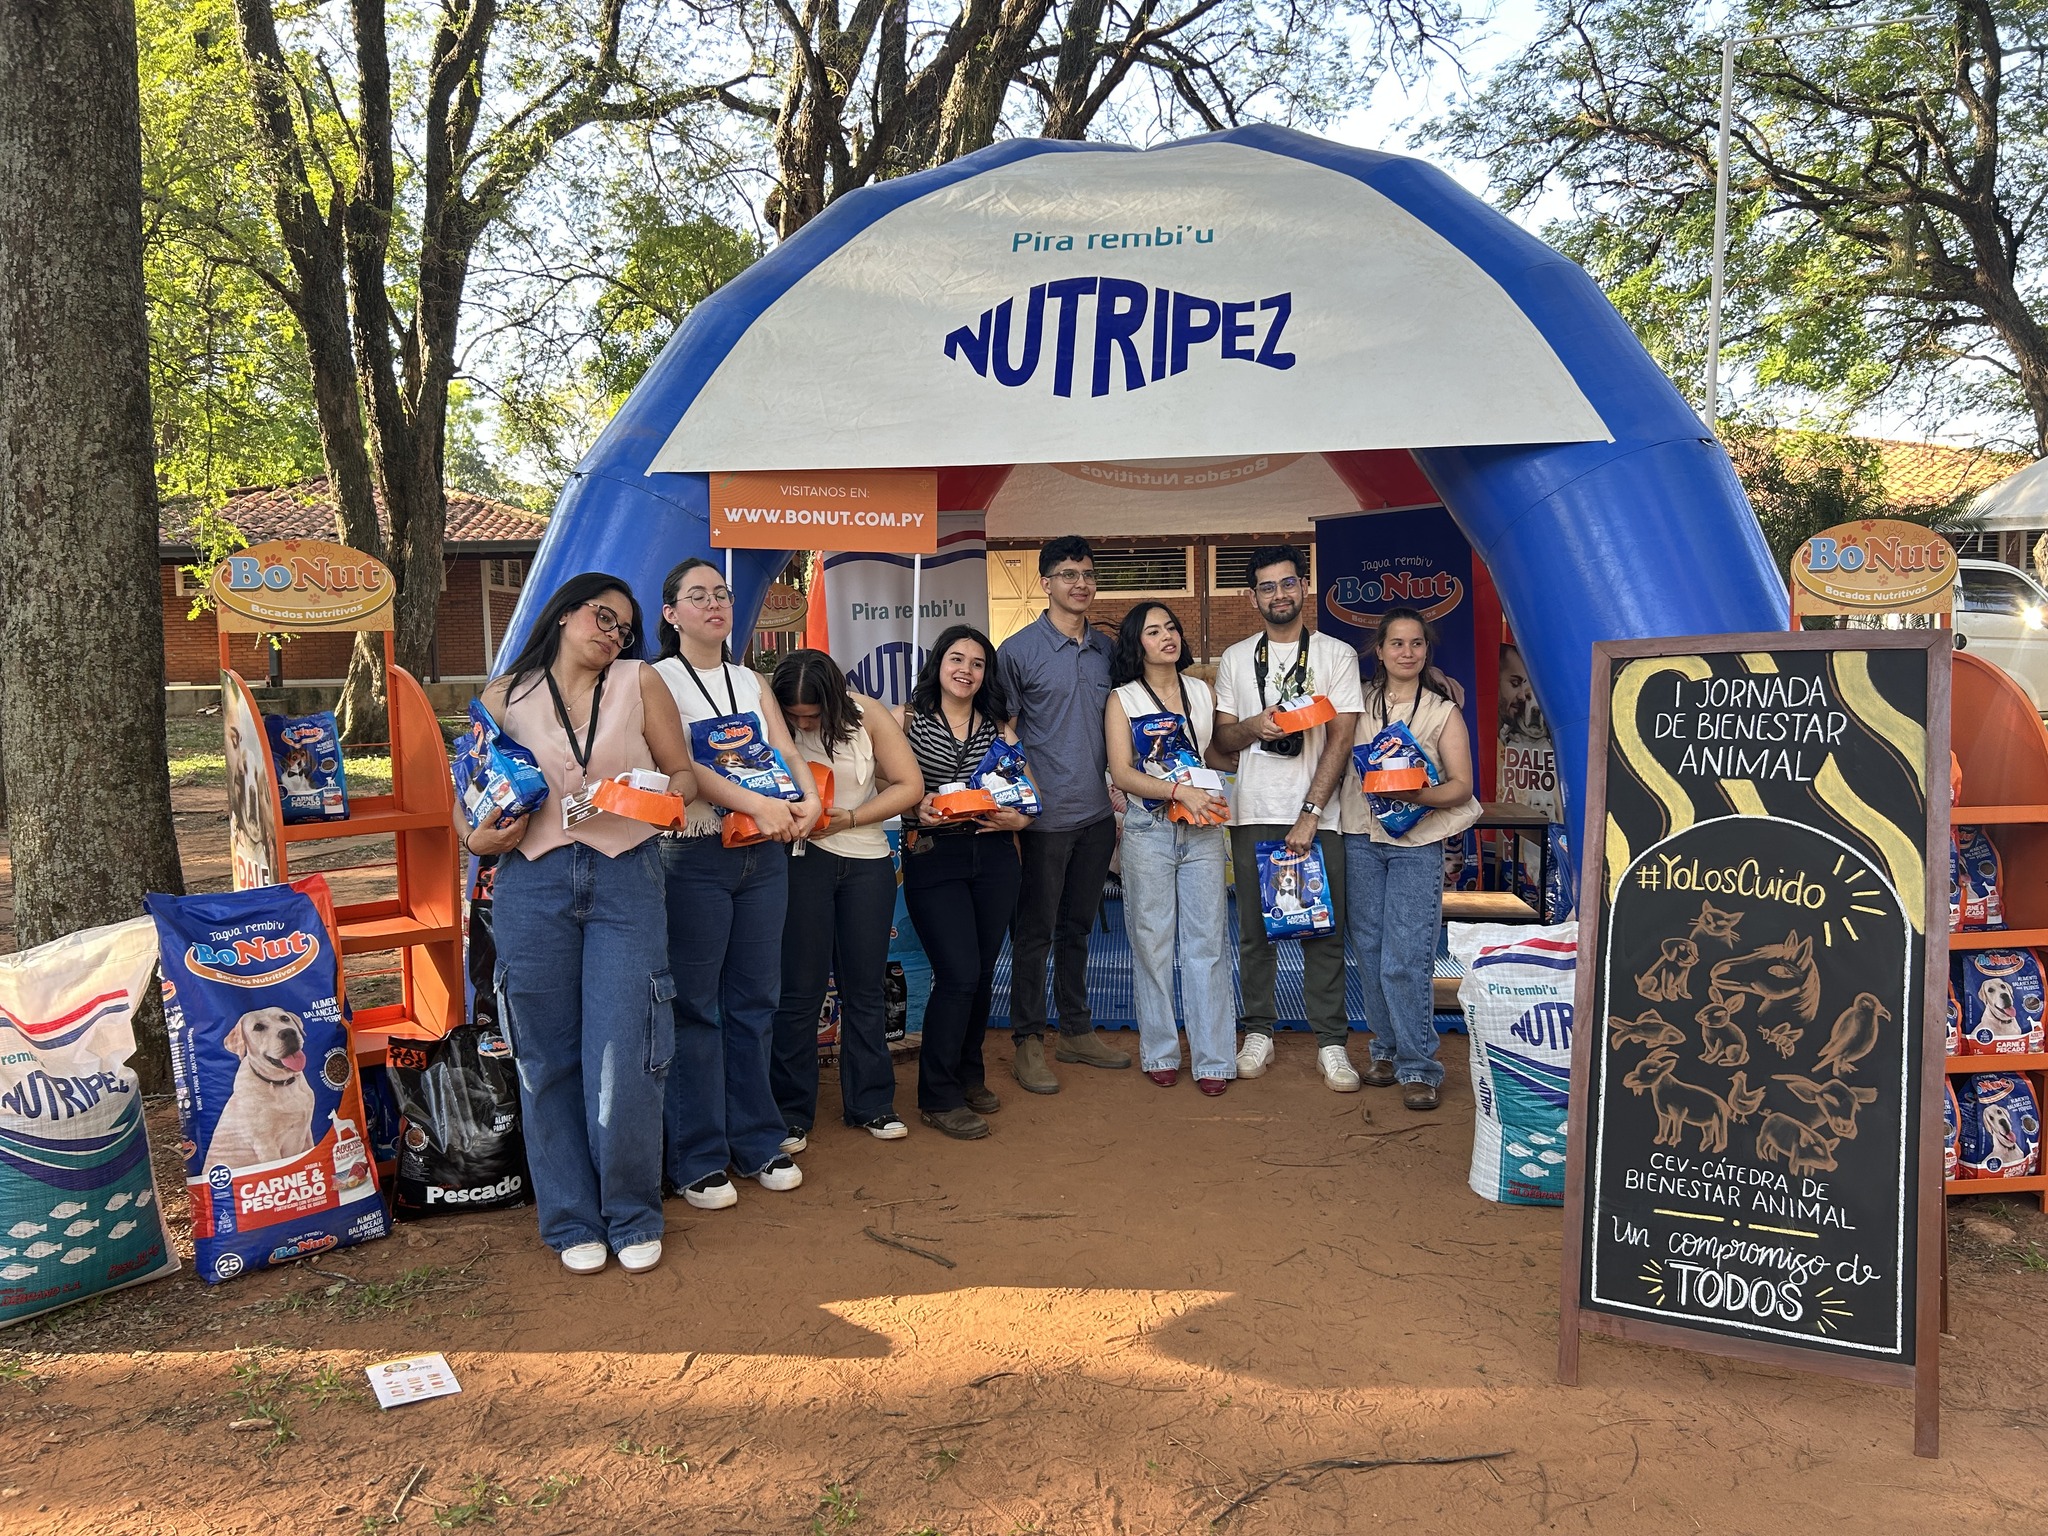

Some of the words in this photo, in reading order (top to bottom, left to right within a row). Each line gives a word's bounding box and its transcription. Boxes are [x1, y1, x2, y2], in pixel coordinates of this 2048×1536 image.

[1011, 231, 1074, 252] Pira
[1087, 225, 1214, 250] rembi'u
[943, 276, 1296, 399] NUTRIPEZ
[780, 485, 846, 498] VISITANOS
[850, 488, 870, 499] EN:
[723, 507, 925, 527] WWW.BONUT.COM.PY
[1808, 536, 1945, 572] BoNut
[227, 556, 382, 593] BoNut
[1336, 571, 1454, 604] BoNut
[1824, 585, 1871, 601] Bocados
[1873, 584, 1927, 601] Nutritivos
[251, 603, 304, 620] Bocados
[305, 602, 363, 619] Nutritivos
[852, 603, 889, 620] Pira
[1695, 676, 1827, 708] JORNADA
[1655, 713, 1686, 740] DE
[1697, 711, 1847, 745] BIENESTAR
[1505, 746, 1555, 771] DALE
[1678, 744, 1812, 781] ANIMAL
[1503, 768, 1555, 792] PURO
[1636, 853, 1826, 909] #YoLosCuido
[192, 930, 309, 966] BoNut
[215, 971, 250, 985] Bocados
[252, 966, 297, 984] Nutritivos
[1488, 983, 1512, 996] Pira
[885, 1029, 903, 1038] scado
[210, 1168, 230, 1183] 25
[240, 1170, 307, 1199] CARNE
[311, 1168, 325, 1182] &
[241, 1182, 326, 1215] PESCADO
[426, 1176, 522, 1204] Pescado
[1625, 1168, 1740, 1207] BIENESTAR
[1751, 1190, 1856, 1230] ANIMAL
[1802, 1178, 1829, 1201] DE
[348, 1217, 384, 1236] BALANCEADO
[357, 1210, 382, 1225] ALIMENTO
[363, 1224, 385, 1237] PERROS
[273, 1234, 335, 1260] BoNut
[1612, 1216, 1651, 1249] Un
[1668, 1231, 1831, 1285] compromiso
[1836, 1254, 1880, 1286] de
[218, 1258, 240, 1272] 25
[1665, 1259, 1803, 1323] TODOS
